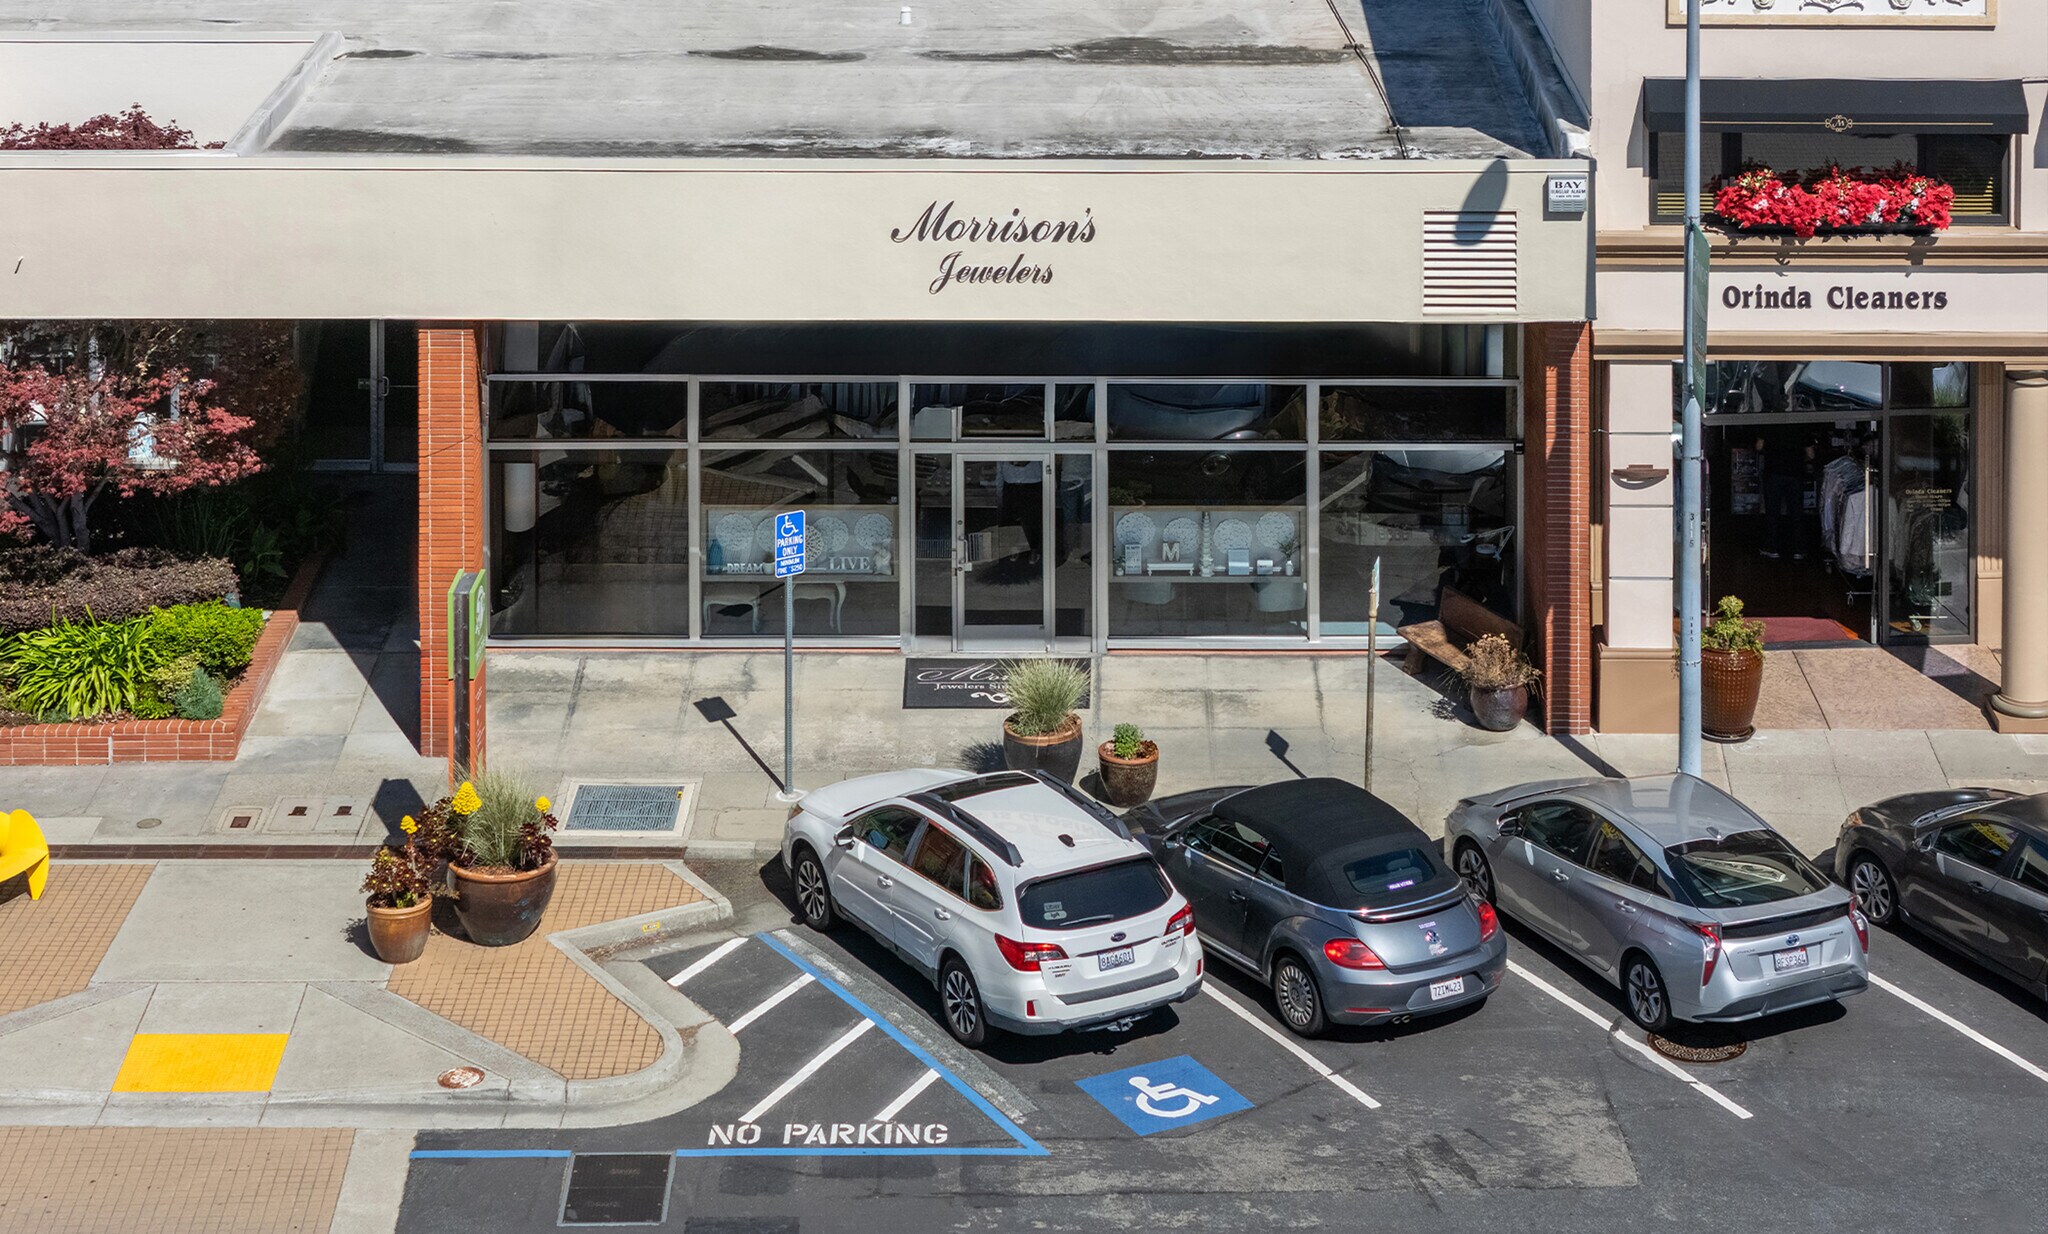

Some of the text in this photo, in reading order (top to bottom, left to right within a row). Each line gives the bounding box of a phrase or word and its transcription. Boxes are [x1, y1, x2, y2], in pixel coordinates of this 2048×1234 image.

[1554, 181, 1582, 189] BAY
[890, 200, 1096, 244] Morrison's
[928, 250, 1053, 295] Jewelers
[1722, 283, 1949, 310] Orinda Cleaners
[777, 535, 803, 548] PARKING
[782, 546, 798, 557] ONLY
[1162, 542, 1180, 561] M
[726, 563, 763, 574] DREAM
[829, 557, 870, 570] LIVE
[933, 682, 985, 691] Jewelers
[707, 1123, 948, 1145] NO PARKING
